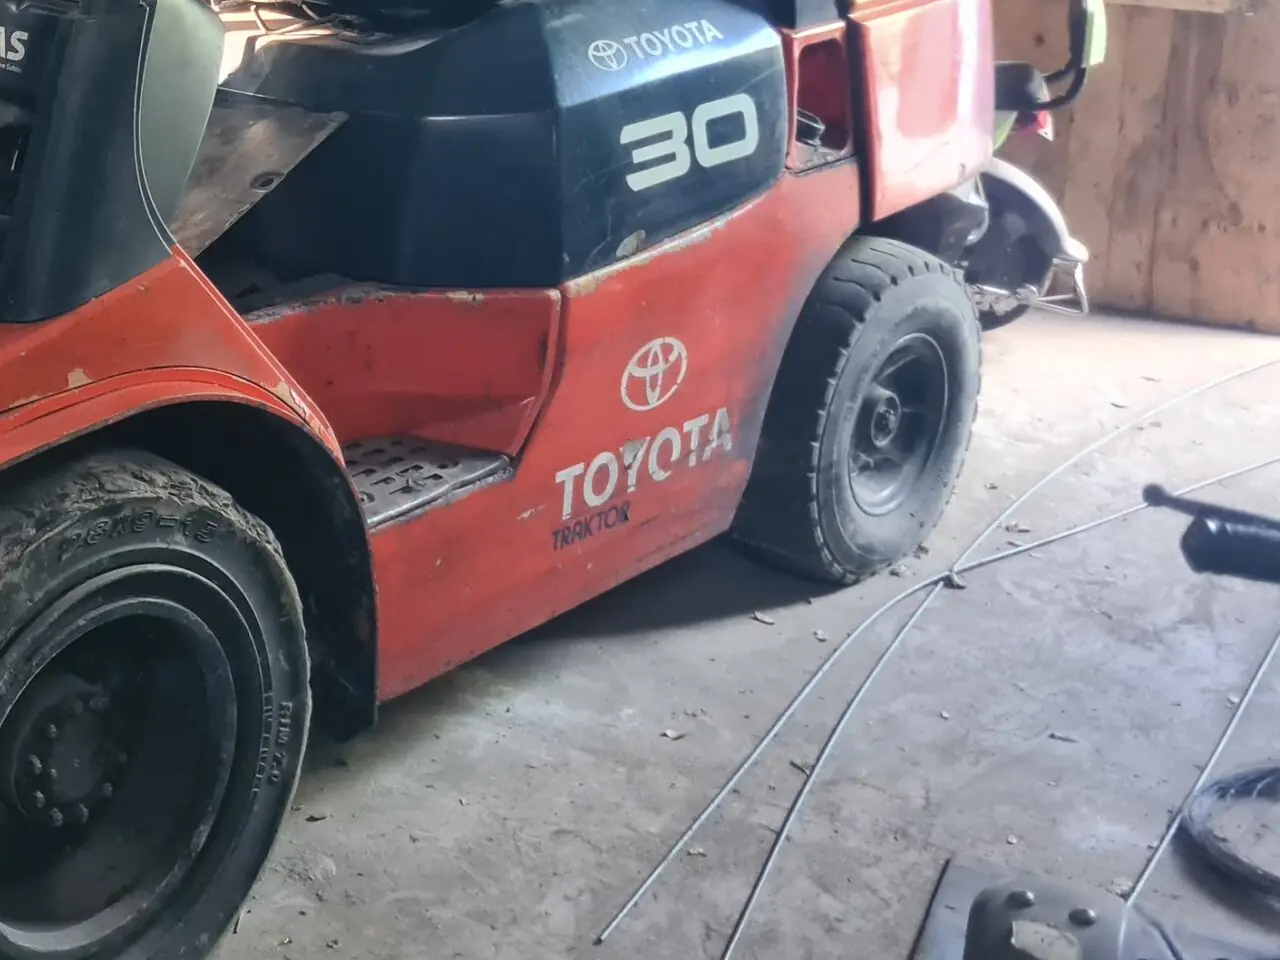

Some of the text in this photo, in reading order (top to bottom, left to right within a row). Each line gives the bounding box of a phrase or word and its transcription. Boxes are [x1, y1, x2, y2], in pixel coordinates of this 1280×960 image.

[623, 19, 724, 61] TOYOTA
[620, 93, 759, 192] 30
[555, 407, 733, 520] TOYOTA
